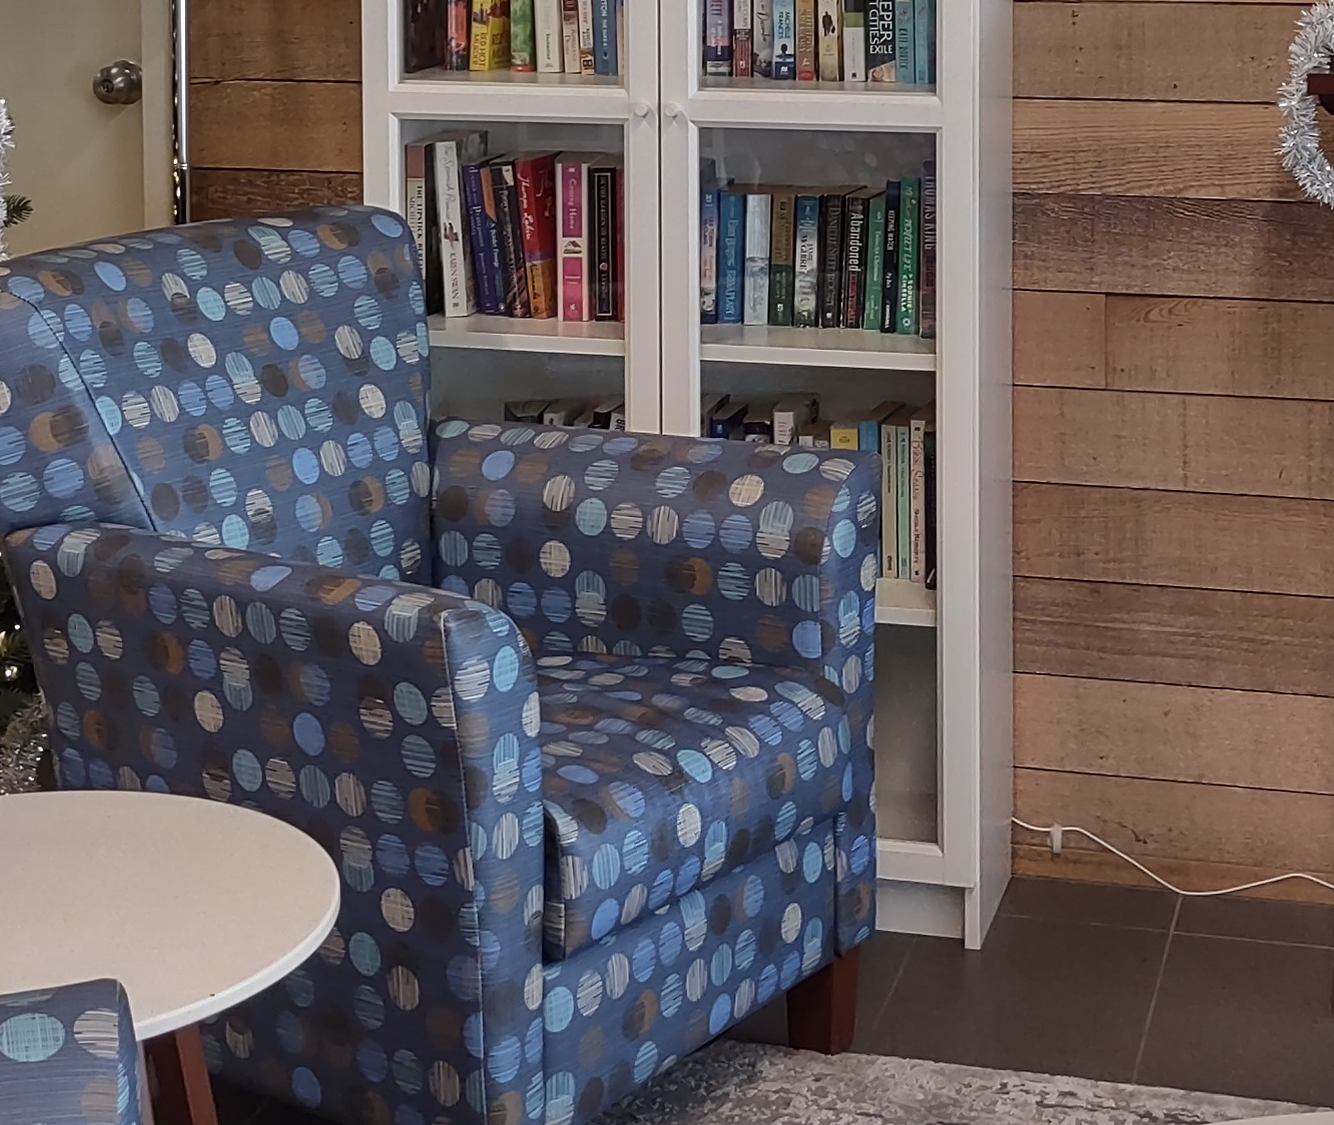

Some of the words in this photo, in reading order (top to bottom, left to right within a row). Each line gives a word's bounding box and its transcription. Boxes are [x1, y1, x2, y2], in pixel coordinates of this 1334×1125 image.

[479, 32, 488, 46] RED
[868, 9, 880, 45] CITIES
[472, 33, 480, 66] MURDER
[478, 48, 487, 66] HOT
[870, 45, 893, 54] EXILE
[416, 185, 424, 199] THE
[567, 178, 577, 205] Coming
[924, 175, 936, 220] THOMAS
[416, 203, 424, 240] LIPSTICK
[568, 208, 578, 230] Home
[887, 209, 895, 232] KEEPING
[848, 212, 864, 272] Abandoned
[886, 233, 895, 251] WATCH
[903, 218, 913, 252] PERFECT
[924, 223, 936, 250] KING
[449, 252, 458, 277] KAREN
[900, 274, 908, 312] KINSELLA
